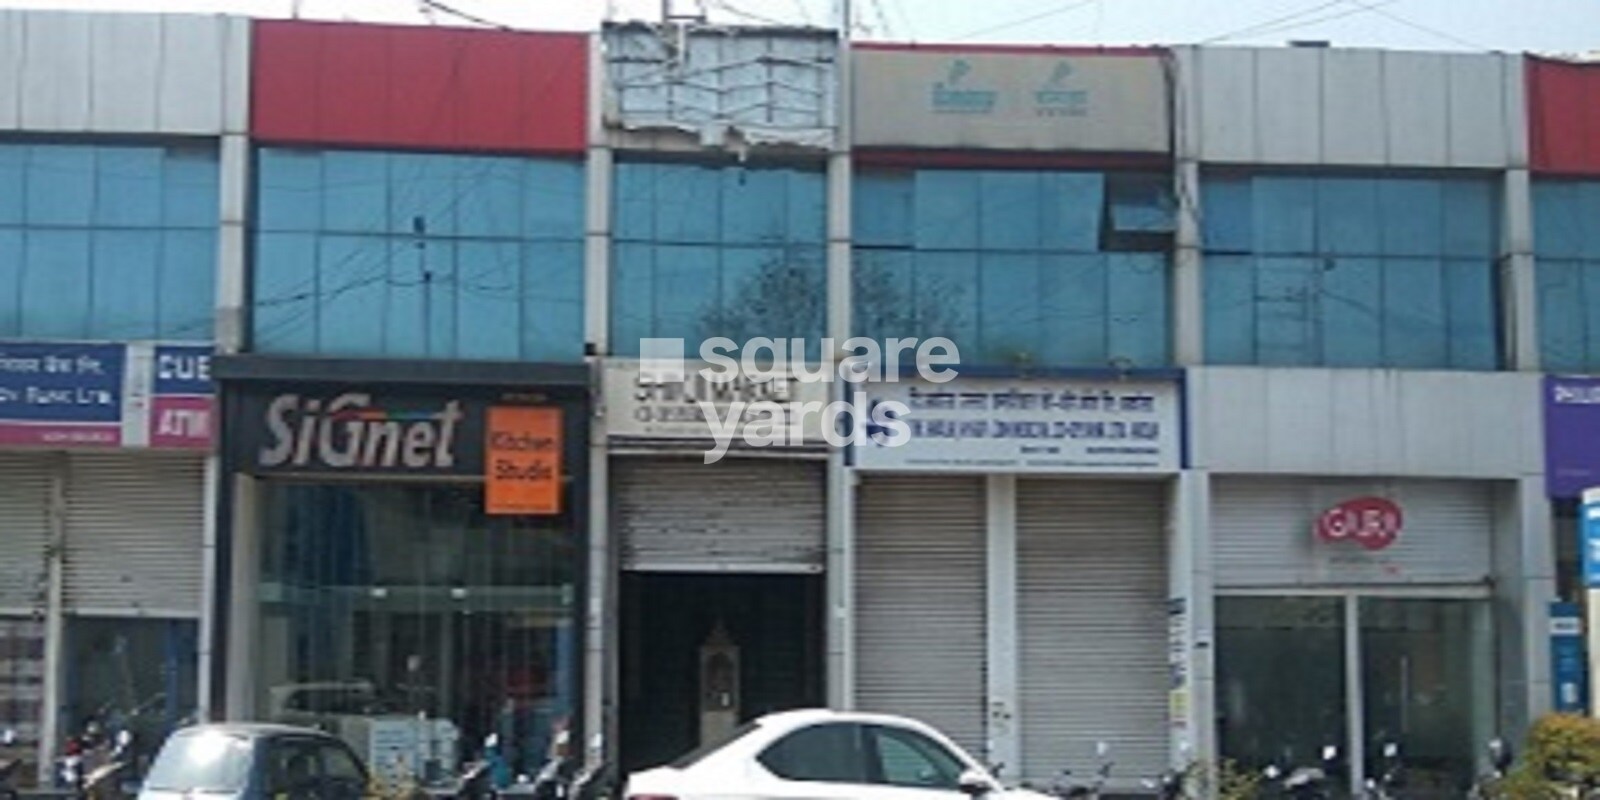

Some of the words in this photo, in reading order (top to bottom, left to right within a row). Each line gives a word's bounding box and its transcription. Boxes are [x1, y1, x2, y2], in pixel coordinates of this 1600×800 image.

[155, 409, 212, 436] ATM
[491, 430, 554, 451] Kitchen
[495, 459, 554, 482] Studio
